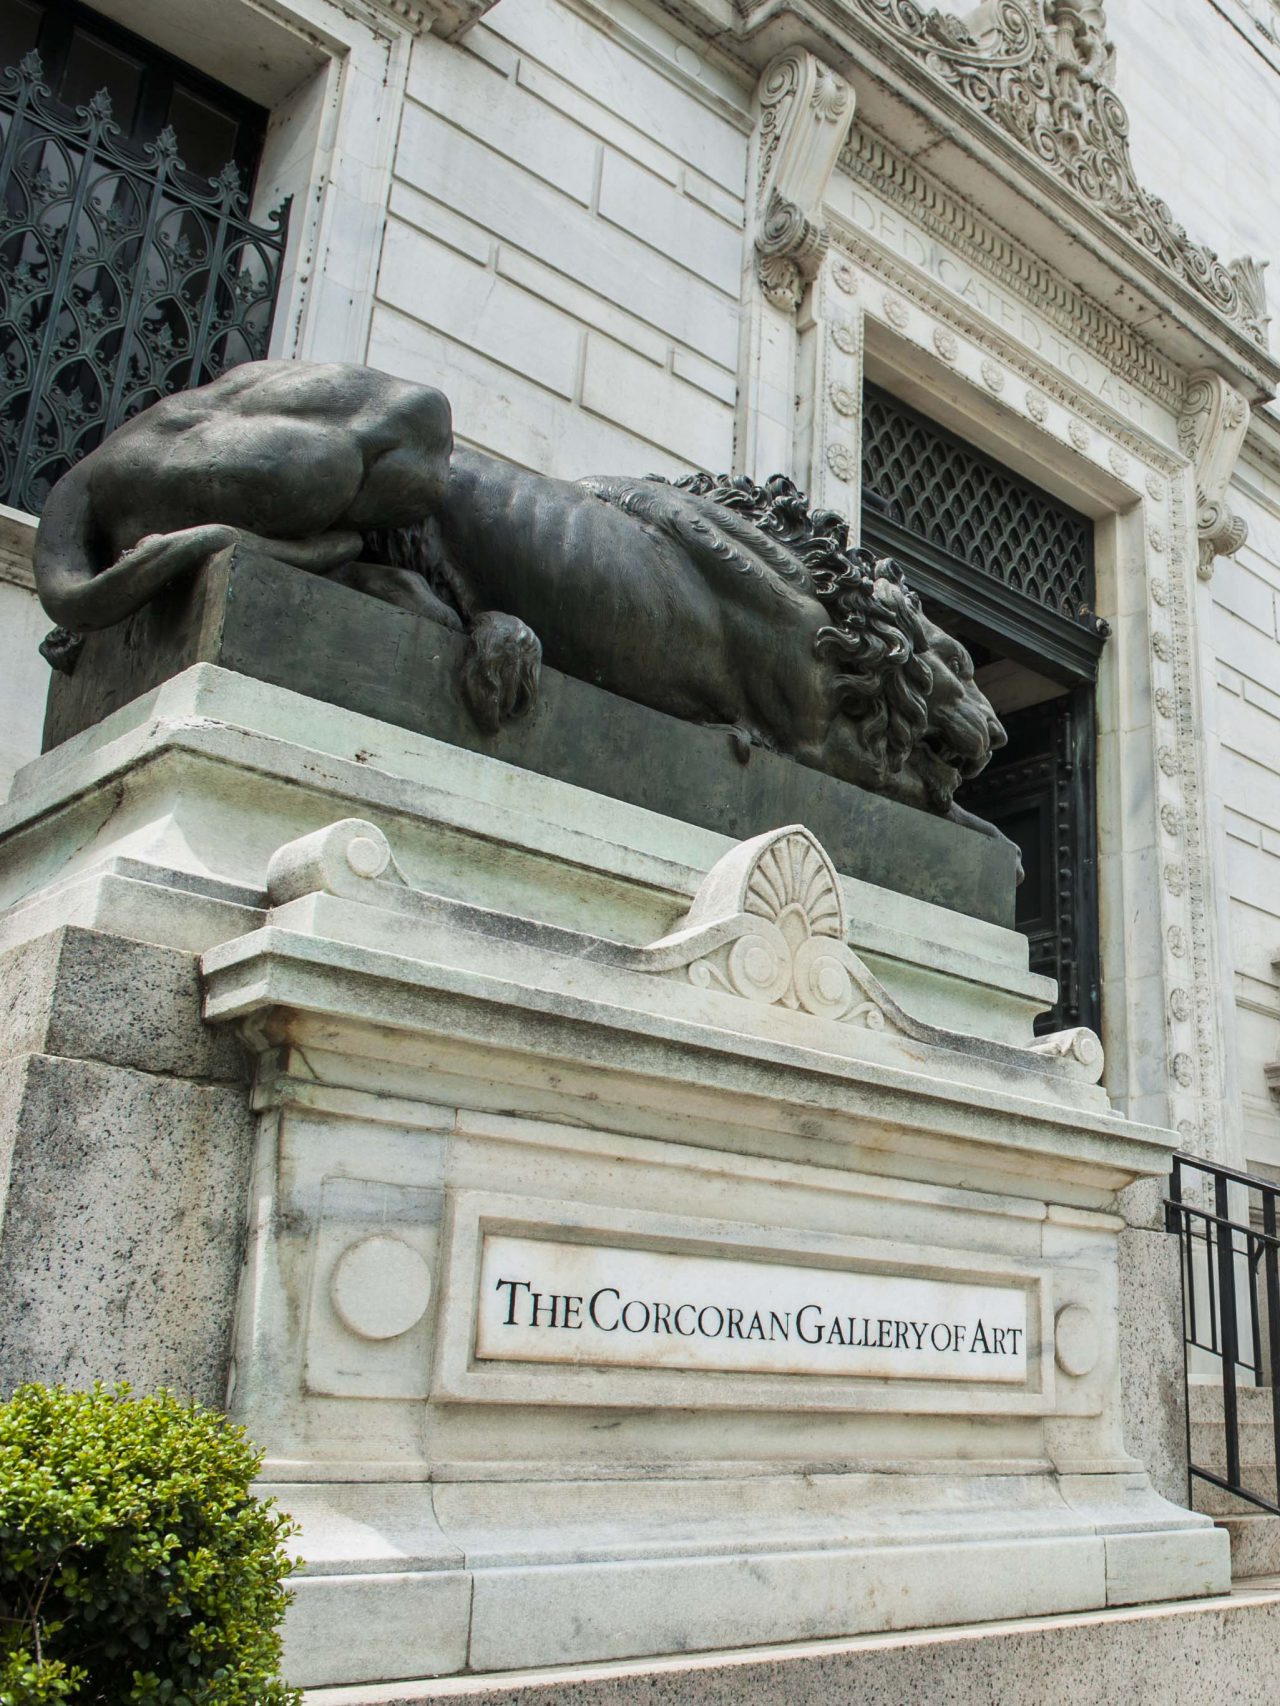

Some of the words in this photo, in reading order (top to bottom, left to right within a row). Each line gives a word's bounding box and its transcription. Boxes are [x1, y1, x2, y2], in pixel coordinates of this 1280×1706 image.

[851, 190, 1042, 352] DEDICATED
[1050, 334, 1089, 385] TO
[1099, 374, 1149, 426] ART
[495, 1278, 583, 1330] THE
[588, 1287, 791, 1341] CORCORAN
[796, 1304, 929, 1350] GALLERY
[969, 1319, 1023, 1355] ART
